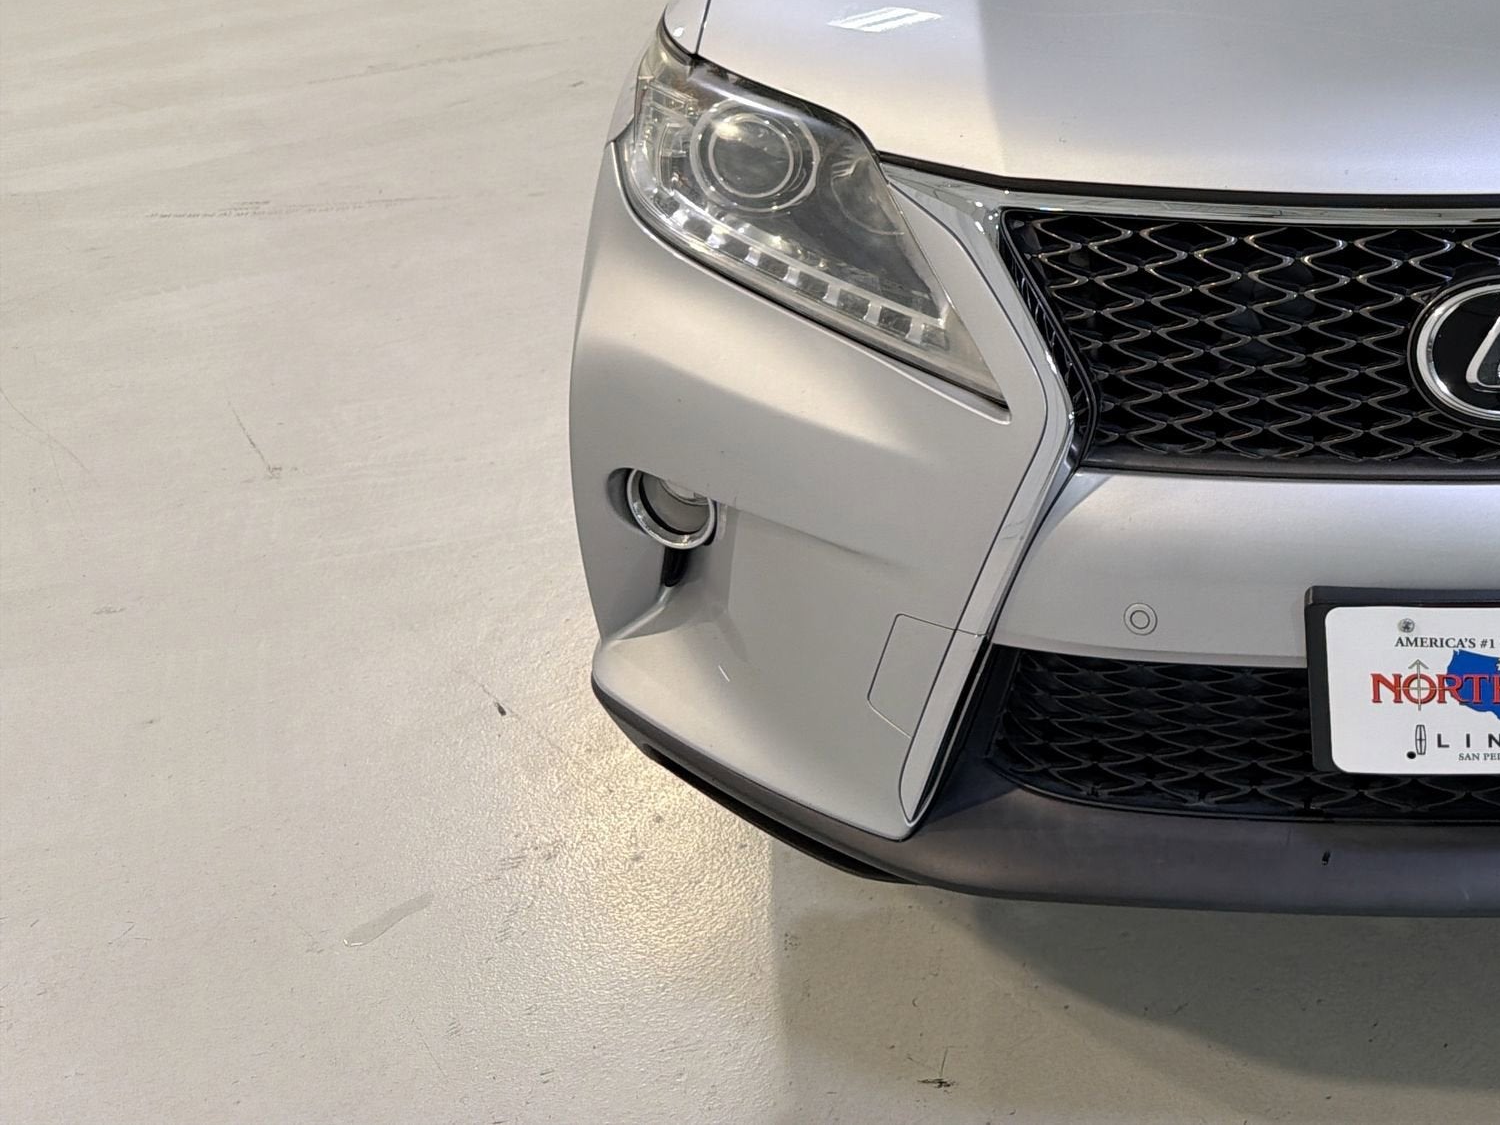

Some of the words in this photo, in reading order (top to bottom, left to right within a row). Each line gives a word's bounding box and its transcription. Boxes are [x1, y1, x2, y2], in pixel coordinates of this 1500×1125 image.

[1394, 636, 1477, 649] AMERICA'S
[1480, 637, 1495, 649] #1
[1458, 752, 1480, 762] SAN
